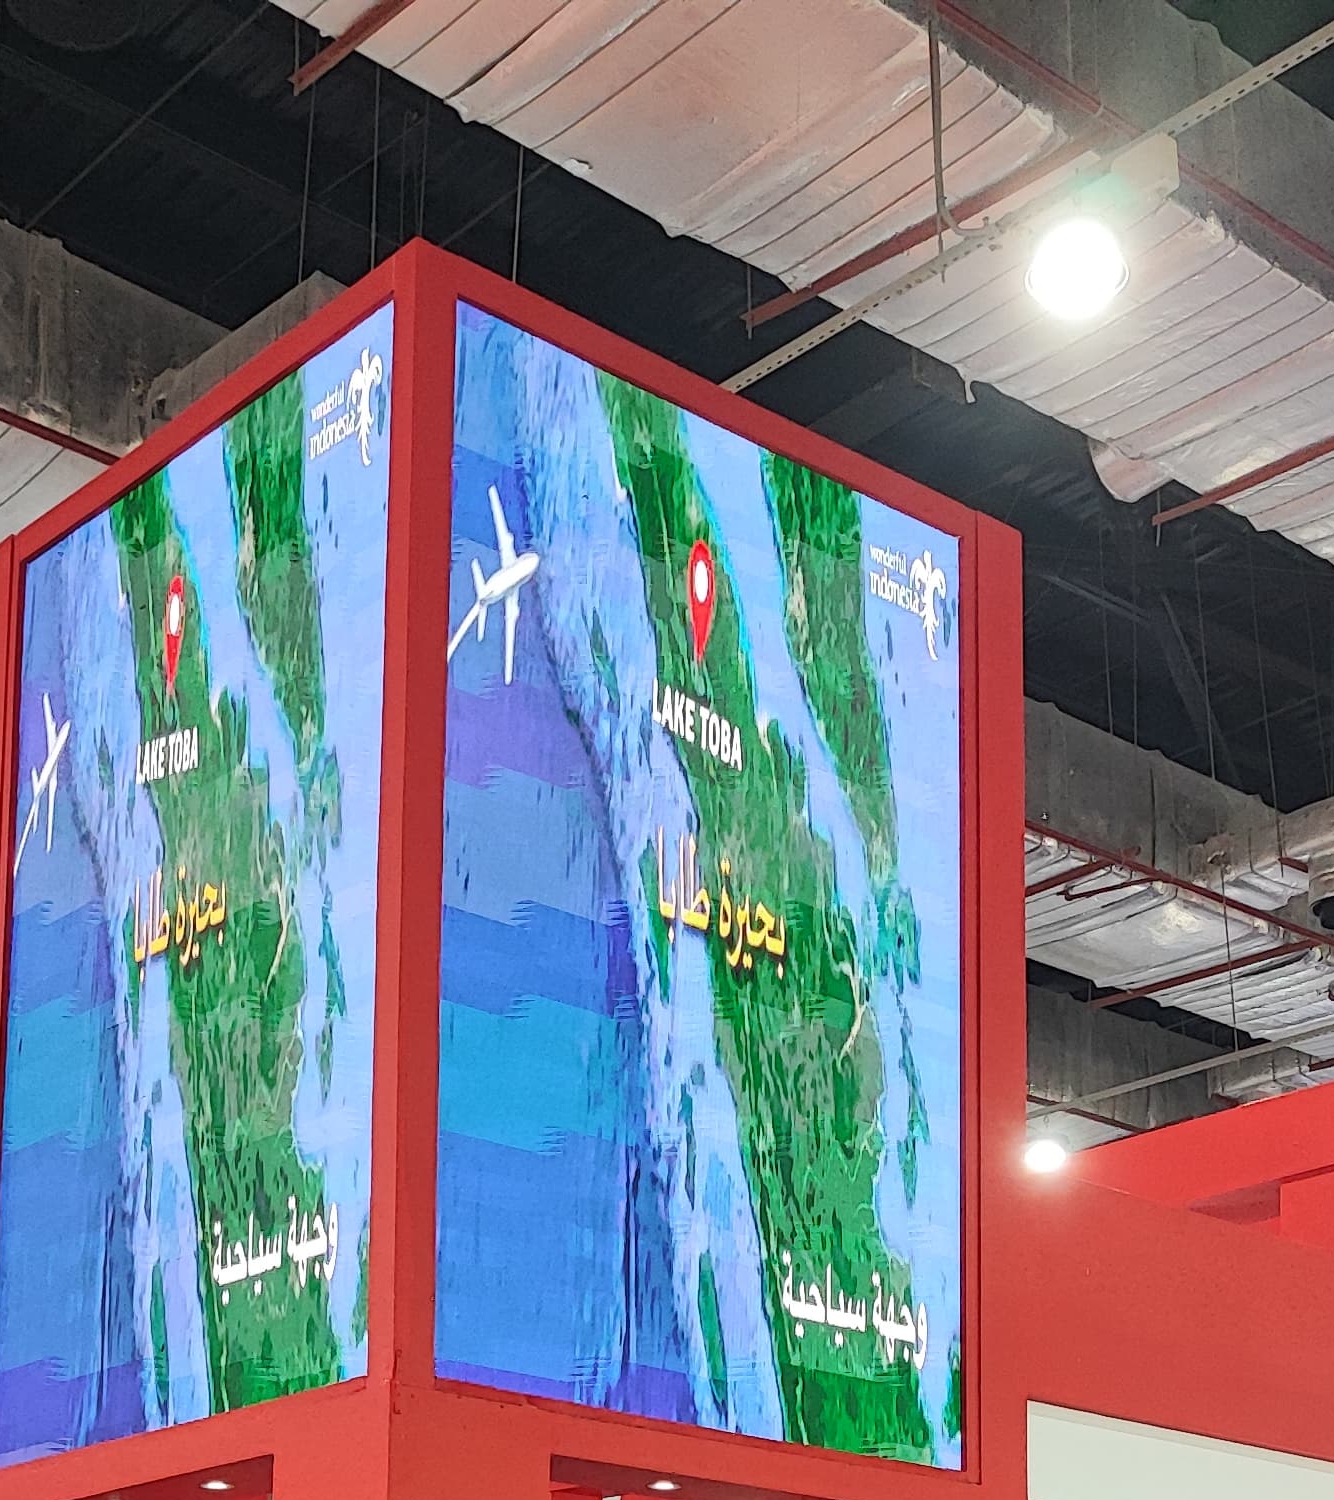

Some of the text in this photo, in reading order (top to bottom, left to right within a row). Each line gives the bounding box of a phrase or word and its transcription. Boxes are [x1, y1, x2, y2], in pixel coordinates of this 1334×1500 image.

[309, 409, 356, 460] indonesia
[310, 380, 345, 423] wonderful
[869, 543, 907, 576] wonderful
[869, 568, 920, 614] indonesia
[135, 725, 199, 784] LAKE TOBA
[651, 676, 743, 771] LAKE TOBA
[134, 864, 226, 983] بحيرة طابا
[657, 825, 786, 980] بحيرة طابا
[213, 1194, 338, 1306] وجهة سياحية
[782, 1249, 929, 1370] وجهة سياحية
